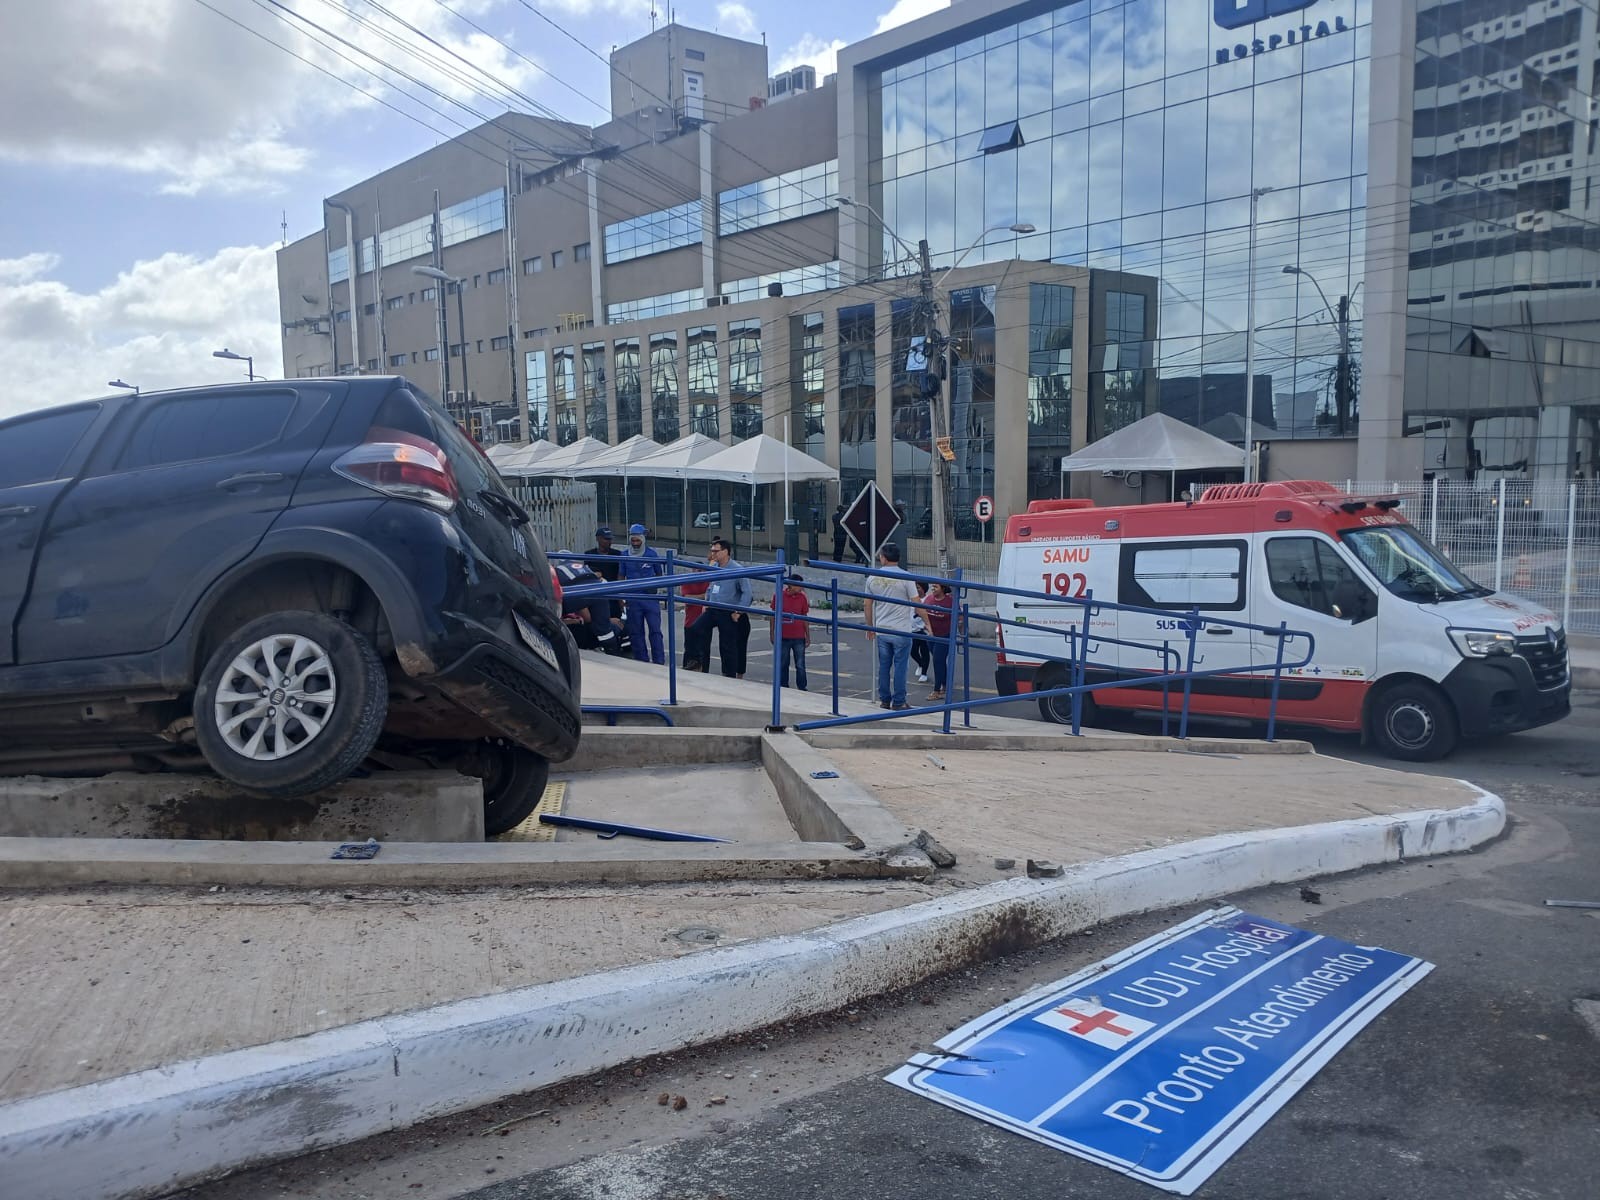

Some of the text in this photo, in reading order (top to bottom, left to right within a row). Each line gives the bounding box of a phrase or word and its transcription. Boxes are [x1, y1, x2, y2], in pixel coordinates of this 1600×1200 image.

[1216, 16, 1347, 64] HOSPITAL
[980, 502, 988, 516] E
[1043, 547, 1090, 564] SAMU
[1042, 573, 1087, 598] 192
[1156, 620, 1176, 630] SUS
[1108, 922, 1292, 1009] UDI Hospital
[1103, 949, 1373, 1135] Pronto Atendimento
